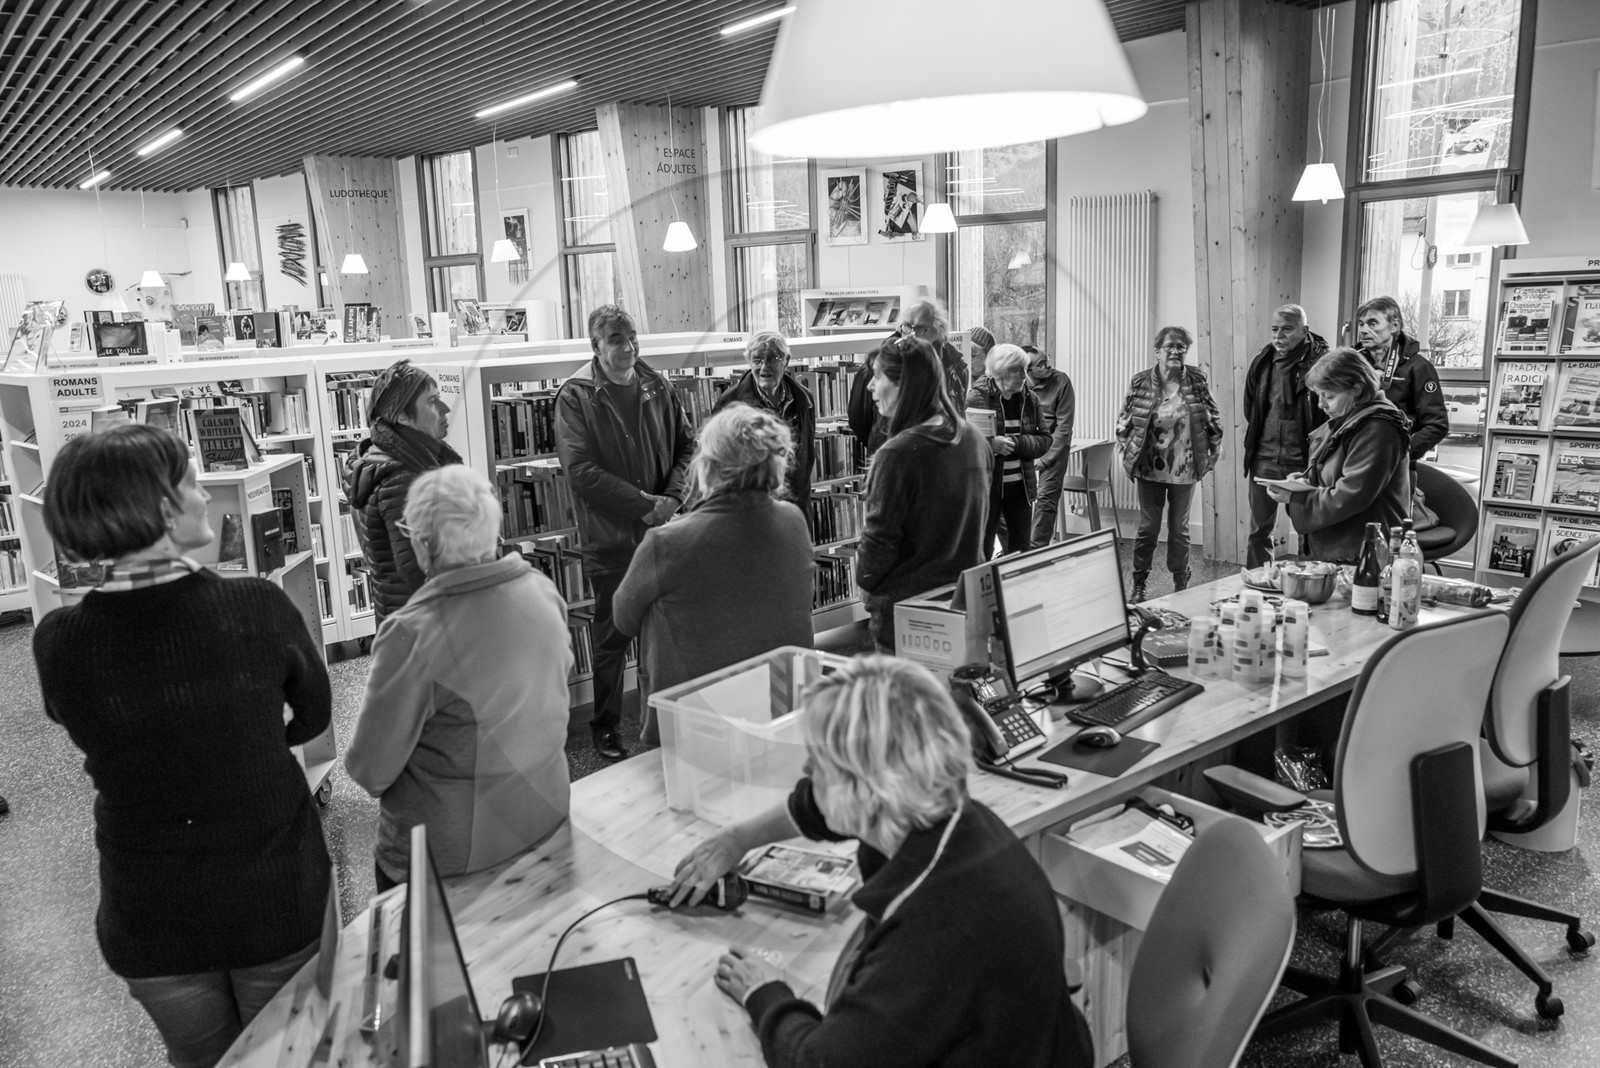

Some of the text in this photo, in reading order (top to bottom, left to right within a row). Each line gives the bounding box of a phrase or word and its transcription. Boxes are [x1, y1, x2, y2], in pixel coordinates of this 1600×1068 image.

[663, 147, 696, 159] ESPACE
[656, 163, 697, 174] ADULTES
[53, 377, 98, 387] ROMANS
[439, 374, 460, 383] ROMANS
[1507, 374, 1542, 383] RADICI
[57, 387, 98, 397] ADULTE
[441, 385, 460, 394] ADULTE
[62, 420, 87, 429] 2024
[202, 417, 234, 427] COLSON
[203, 438, 242, 451] HARLEM
[1568, 442, 1600, 450] SPORTS
[1558, 454, 1585, 465] trek
